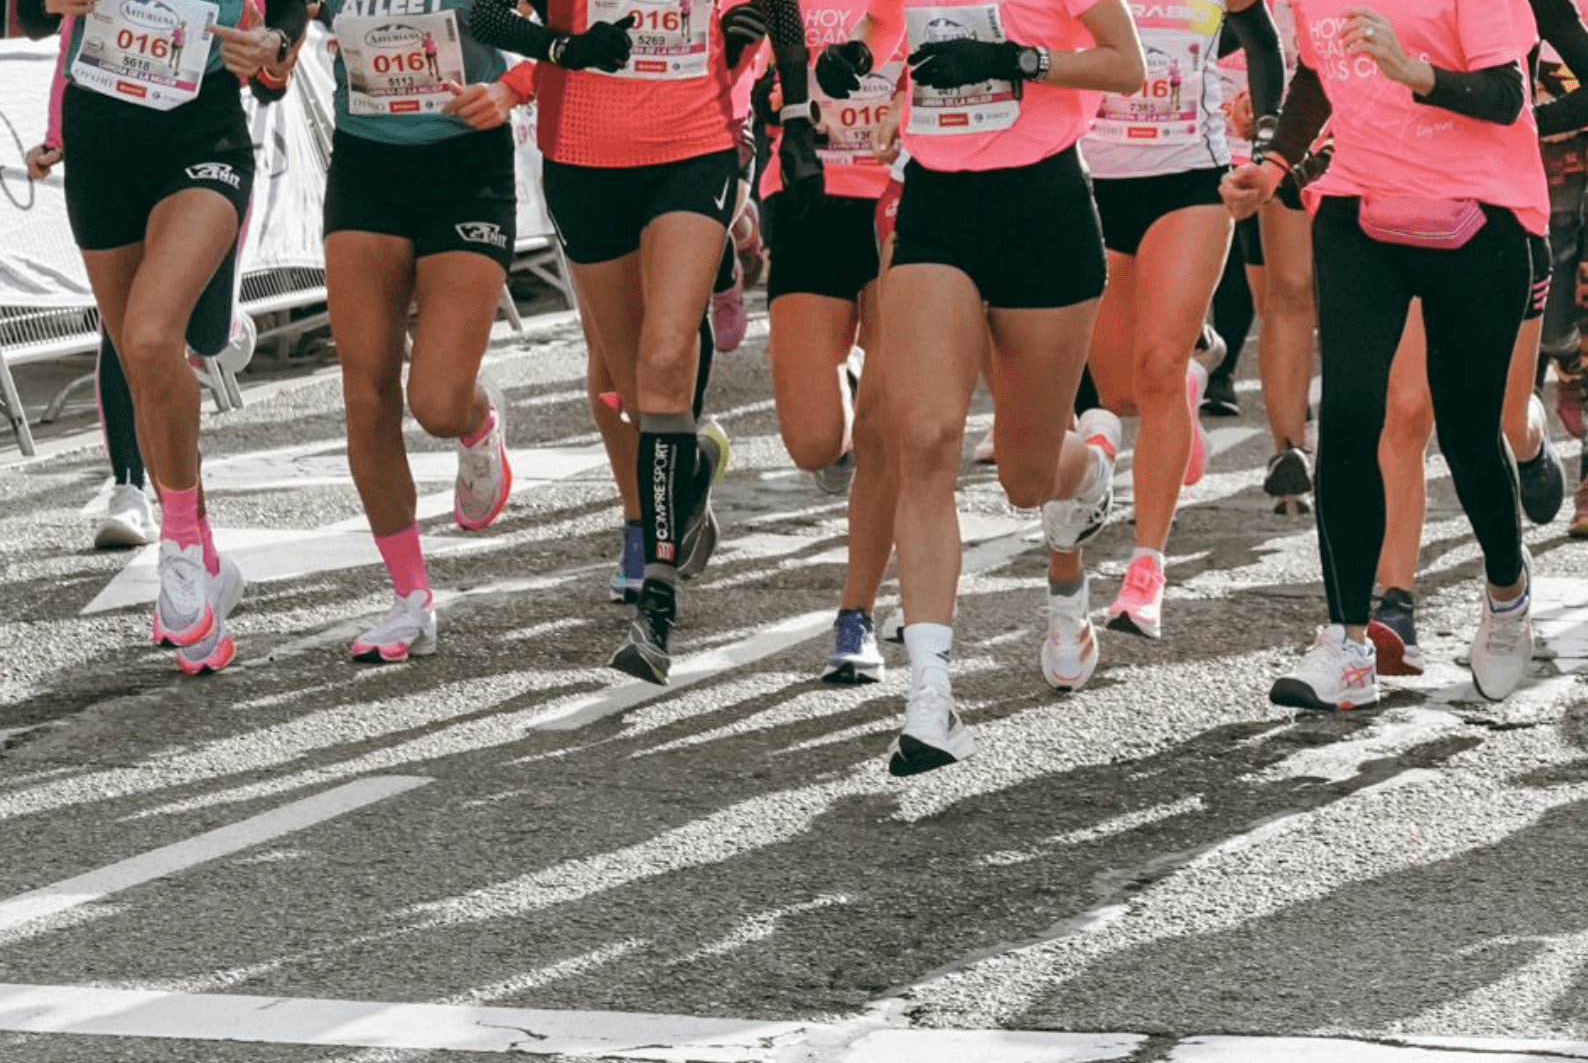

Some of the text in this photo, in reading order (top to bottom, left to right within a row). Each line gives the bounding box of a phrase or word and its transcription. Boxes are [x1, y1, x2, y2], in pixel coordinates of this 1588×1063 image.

[628, 9, 679, 32] 016
[805, 9, 852, 28] HOY
[117, 28, 170, 59] 016
[373, 52, 425, 74] 016
